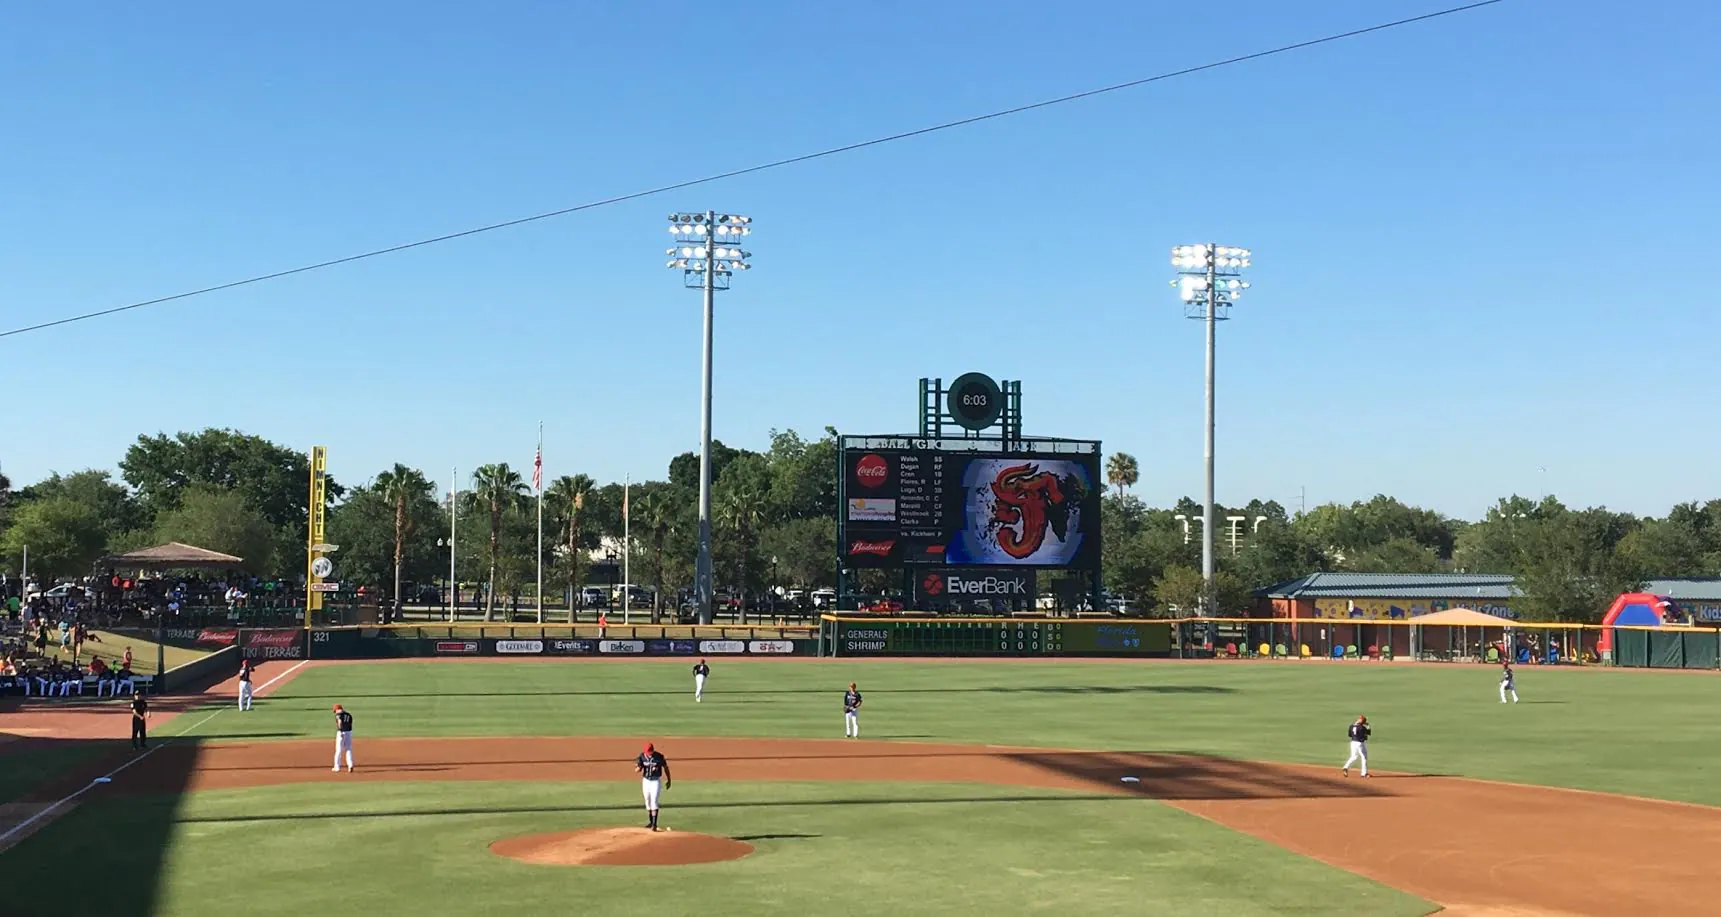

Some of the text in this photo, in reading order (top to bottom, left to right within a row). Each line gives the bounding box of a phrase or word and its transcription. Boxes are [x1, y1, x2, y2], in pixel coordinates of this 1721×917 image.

[963, 395, 987, 406] 6:03
[857, 465, 887, 478] Coca-Cola
[316, 448, 324, 534] NIMNICHT
[947, 576, 1026, 594] EverBank
[1699, 604, 1721, 619] Kid
[314, 632, 330, 642] 321
[847, 630, 1038, 639] GENERALS 0 0 0
[847, 641, 1038, 650] SHRIMP 0 0 0
[242, 646, 301, 658] TIKI TERRACE
